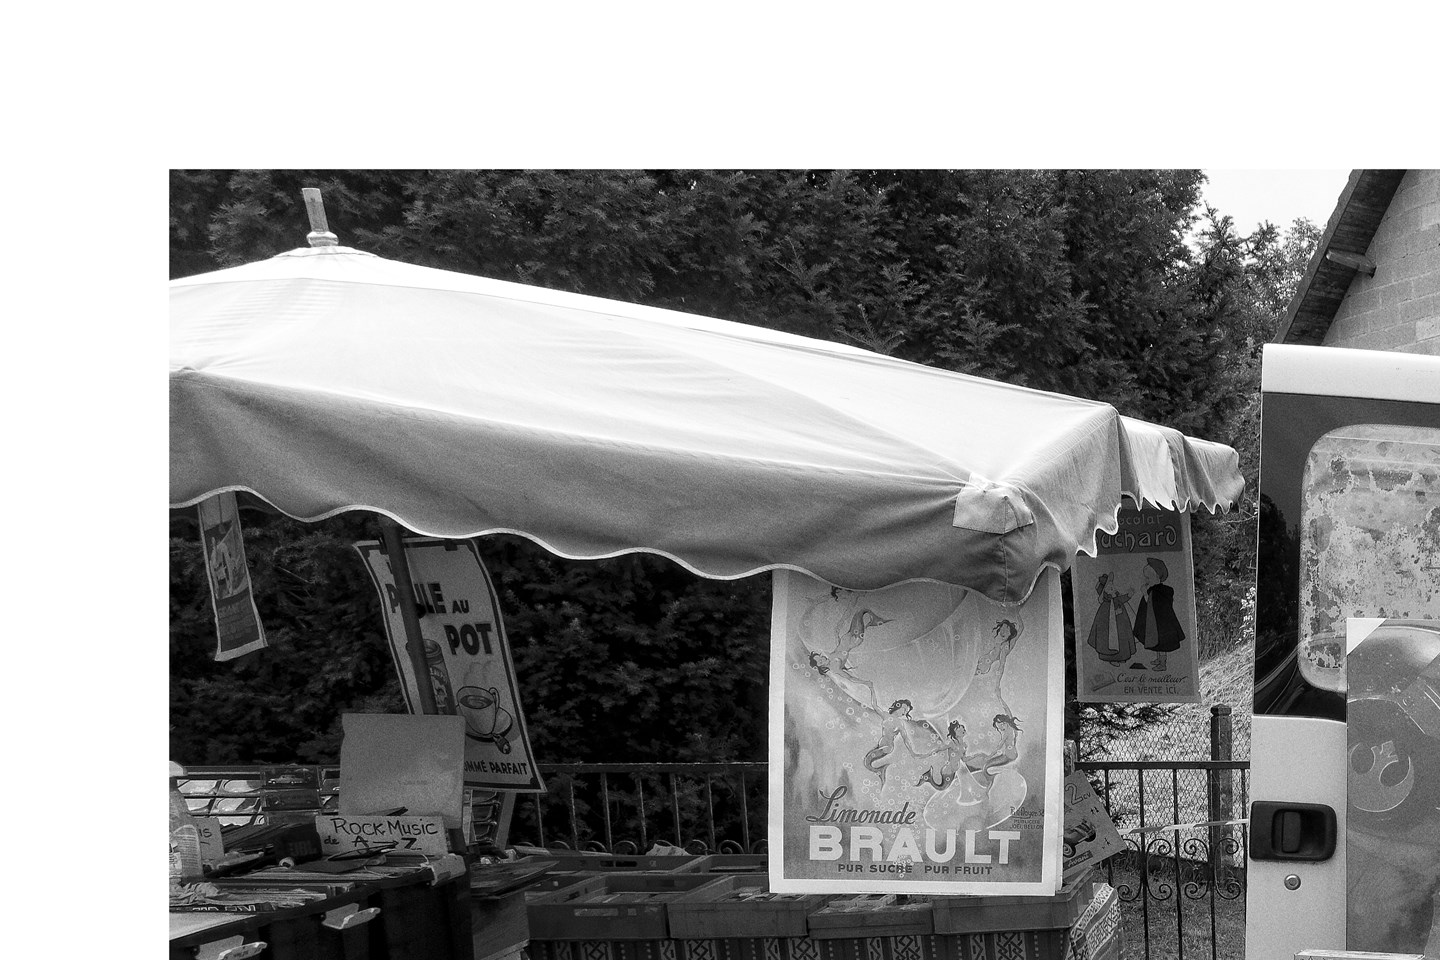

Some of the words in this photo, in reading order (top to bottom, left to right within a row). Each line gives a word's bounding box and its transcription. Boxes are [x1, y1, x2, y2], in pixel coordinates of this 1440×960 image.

[1118, 513, 1163, 525] ocolat
[1101, 525, 1177, 552] uchard
[452, 600, 470, 614] AU
[444, 623, 493, 656] POT
[1138, 686, 1162, 694] VENTE
[489, 761, 528, 775] PARFAIT
[805, 785, 916, 825] Limonade
[323, 835, 340, 846] de
[351, 835, 369, 853] A
[809, 825, 1021, 865] BRAULT
[838, 864, 864, 873] PUR
[869, 864, 913, 874] SUCRE
[924, 865, 950, 875] PUR
[954, 866, 993, 875] FRUIT
